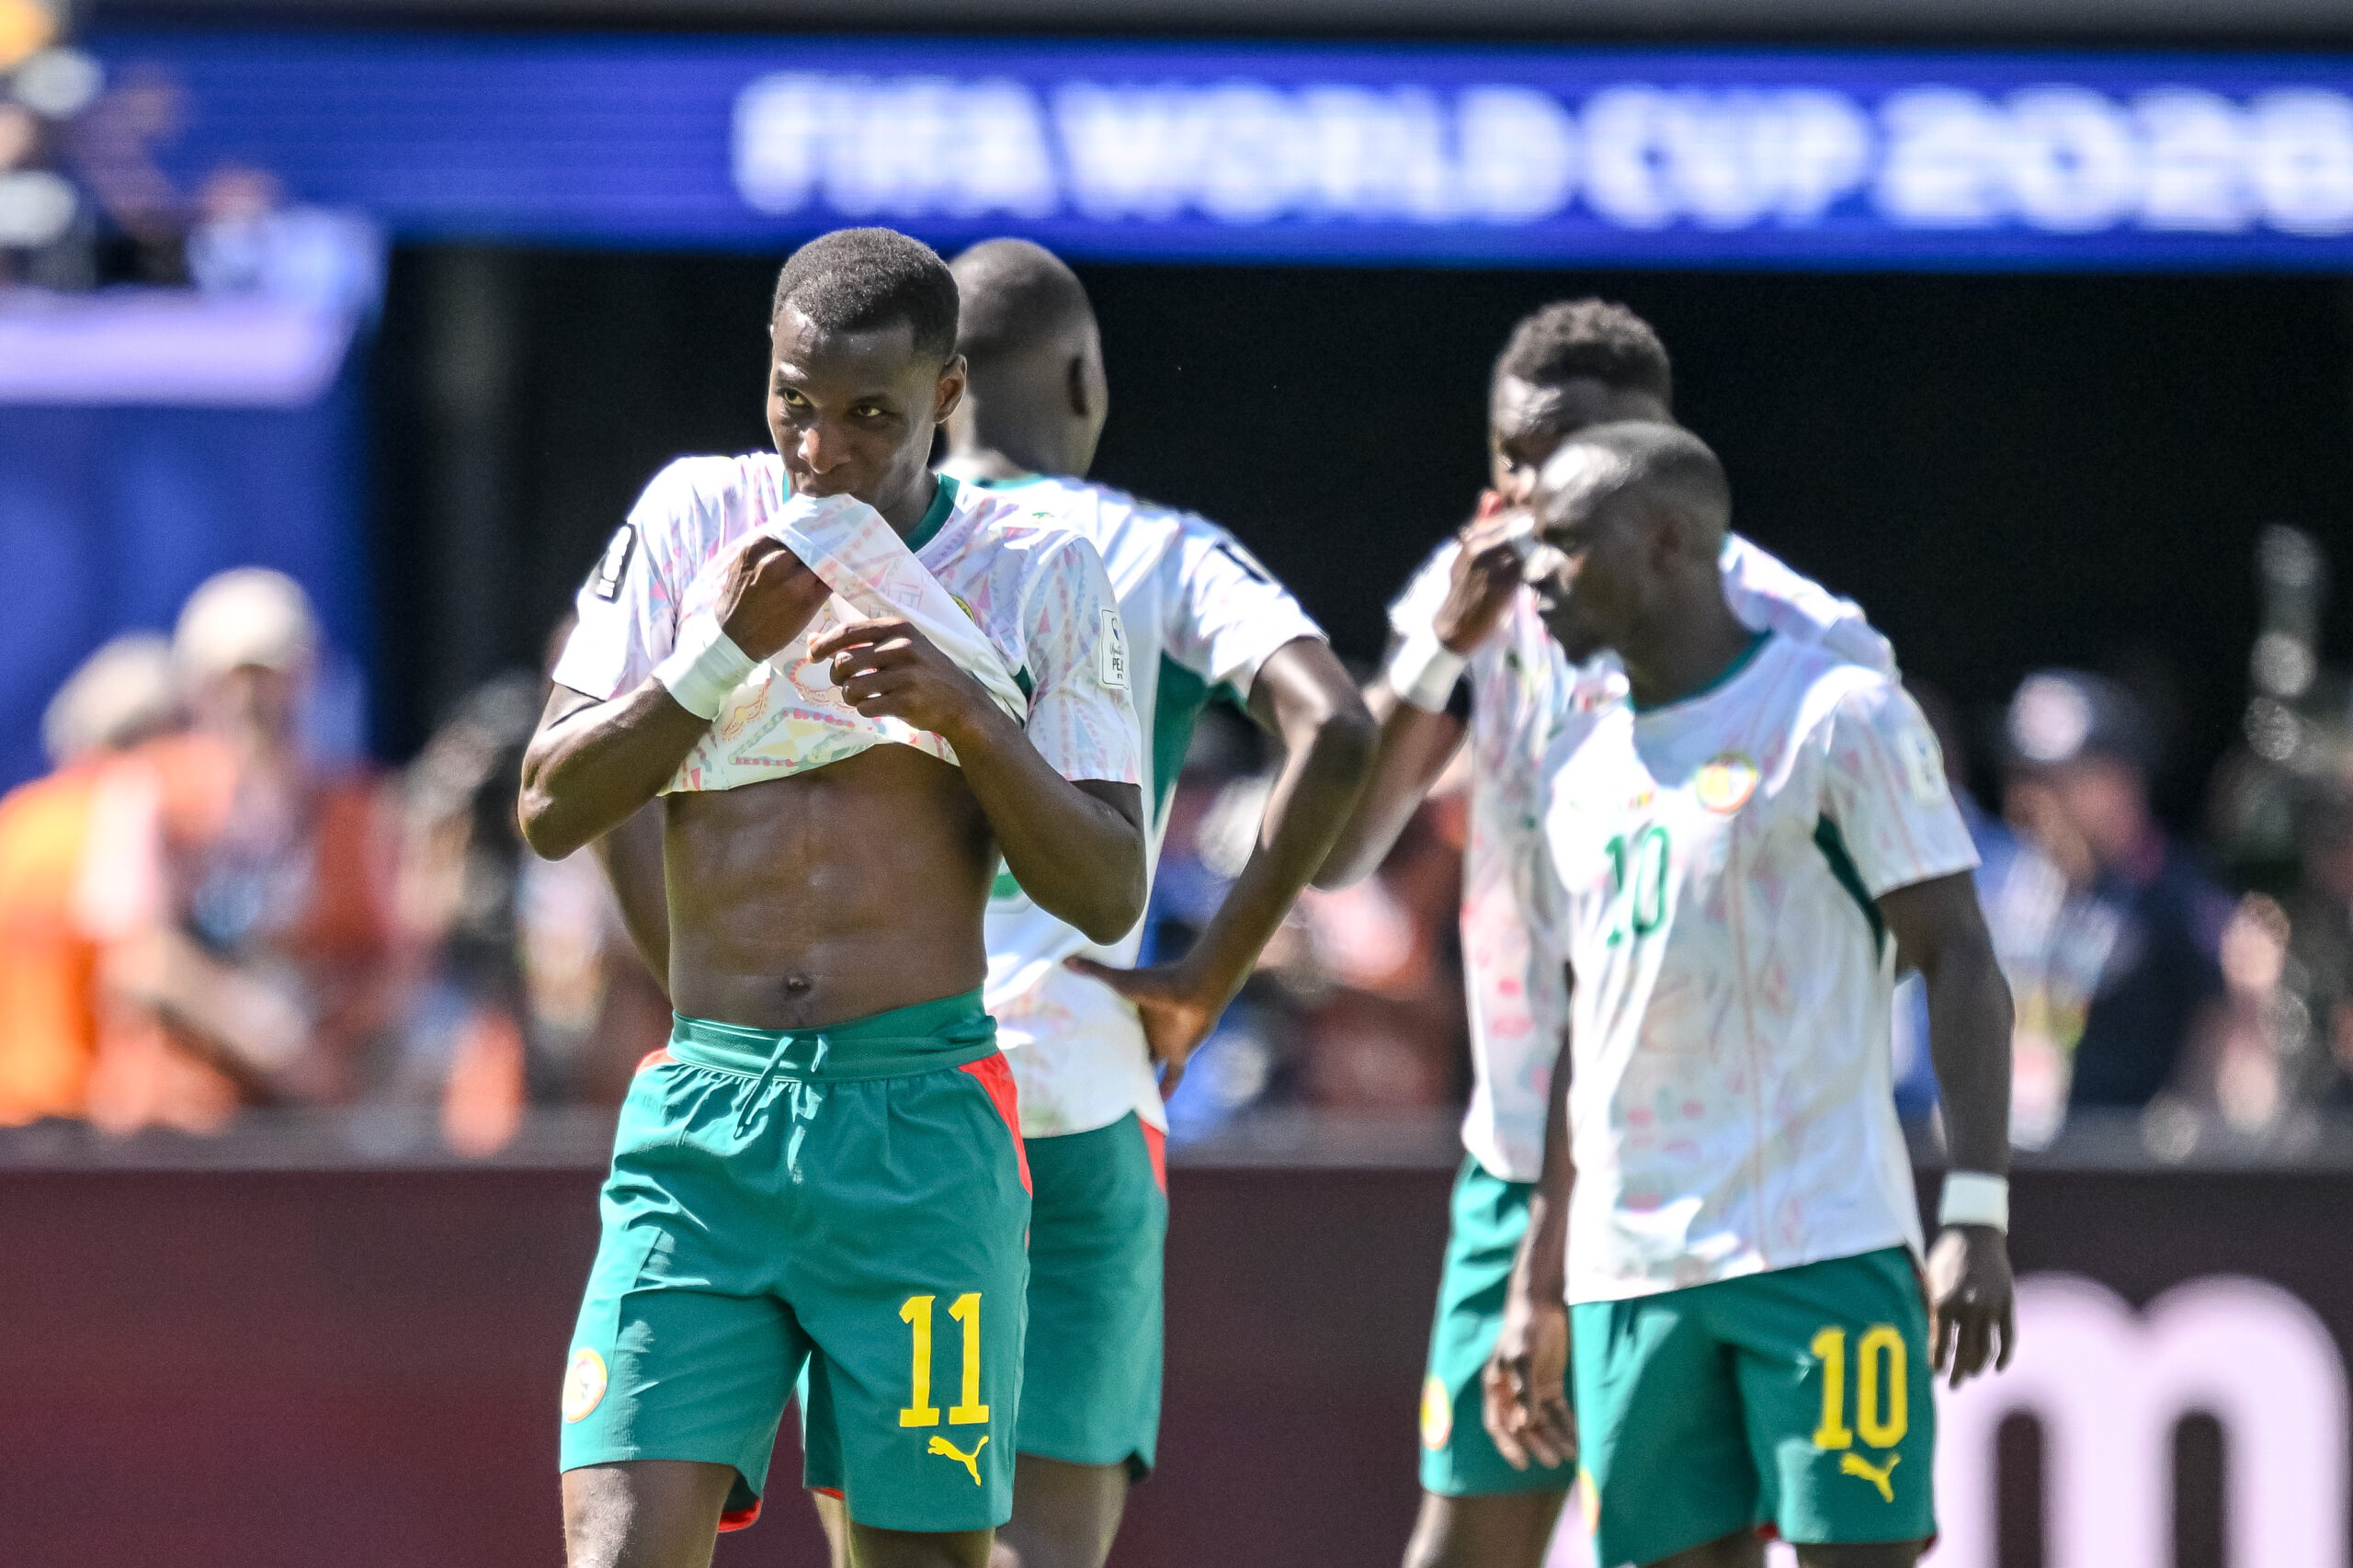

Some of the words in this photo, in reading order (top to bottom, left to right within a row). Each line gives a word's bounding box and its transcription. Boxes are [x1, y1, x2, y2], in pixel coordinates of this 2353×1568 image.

[739, 74, 1053, 219] FIFA
[1057, 81, 1575, 226] WORLD
[1579, 85, 1871, 230] CUP
[1604, 820, 1669, 946] 10
[899, 1292, 990, 1427] 11
[1810, 1324, 1909, 1449] 10
